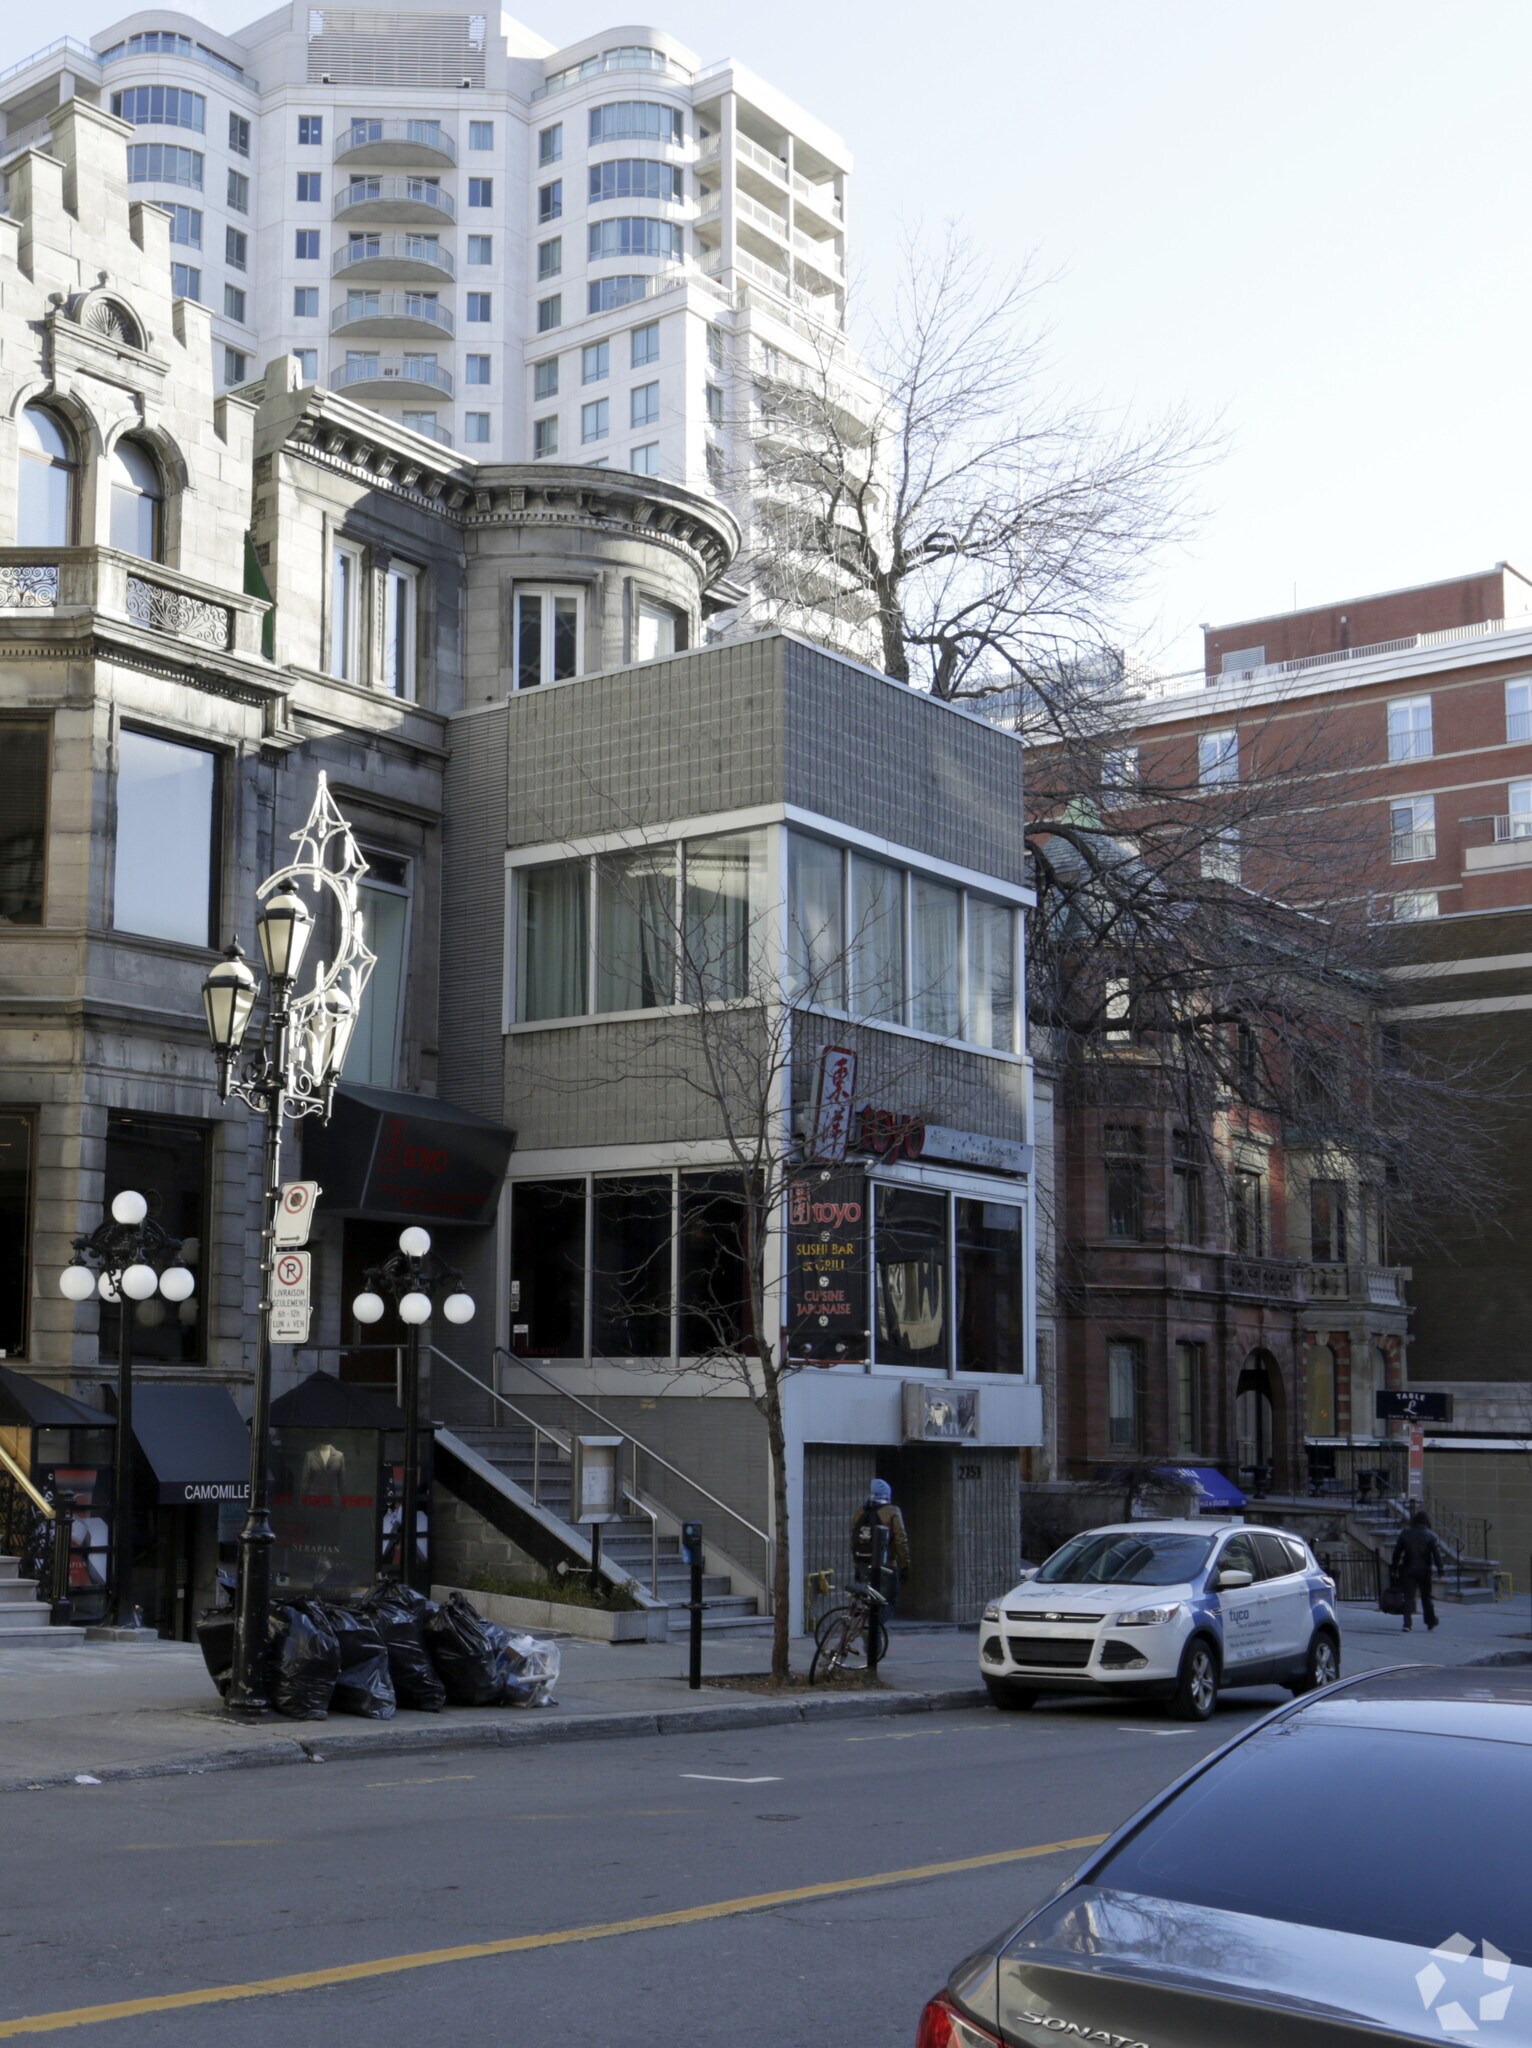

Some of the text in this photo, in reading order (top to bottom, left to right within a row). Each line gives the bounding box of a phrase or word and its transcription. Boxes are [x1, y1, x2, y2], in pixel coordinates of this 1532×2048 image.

[861, 1103, 926, 1167] toyo
[812, 1202, 861, 1229] toyo
[796, 1242, 854, 1256] SUSHI BAR
[274, 1288, 305, 1297] LIVRAISON
[272, 1299, 306, 1308] SEULEMENT
[272, 1320, 285, 1329] LUN
[293, 1320, 305, 1328] VEN
[1396, 1393, 1426, 1401] TABLE
[184, 1484, 251, 1500] CAMOMILLE
[291, 1543, 340, 1553] SERAPIAN
[1229, 1608, 1249, 1624] tyco
